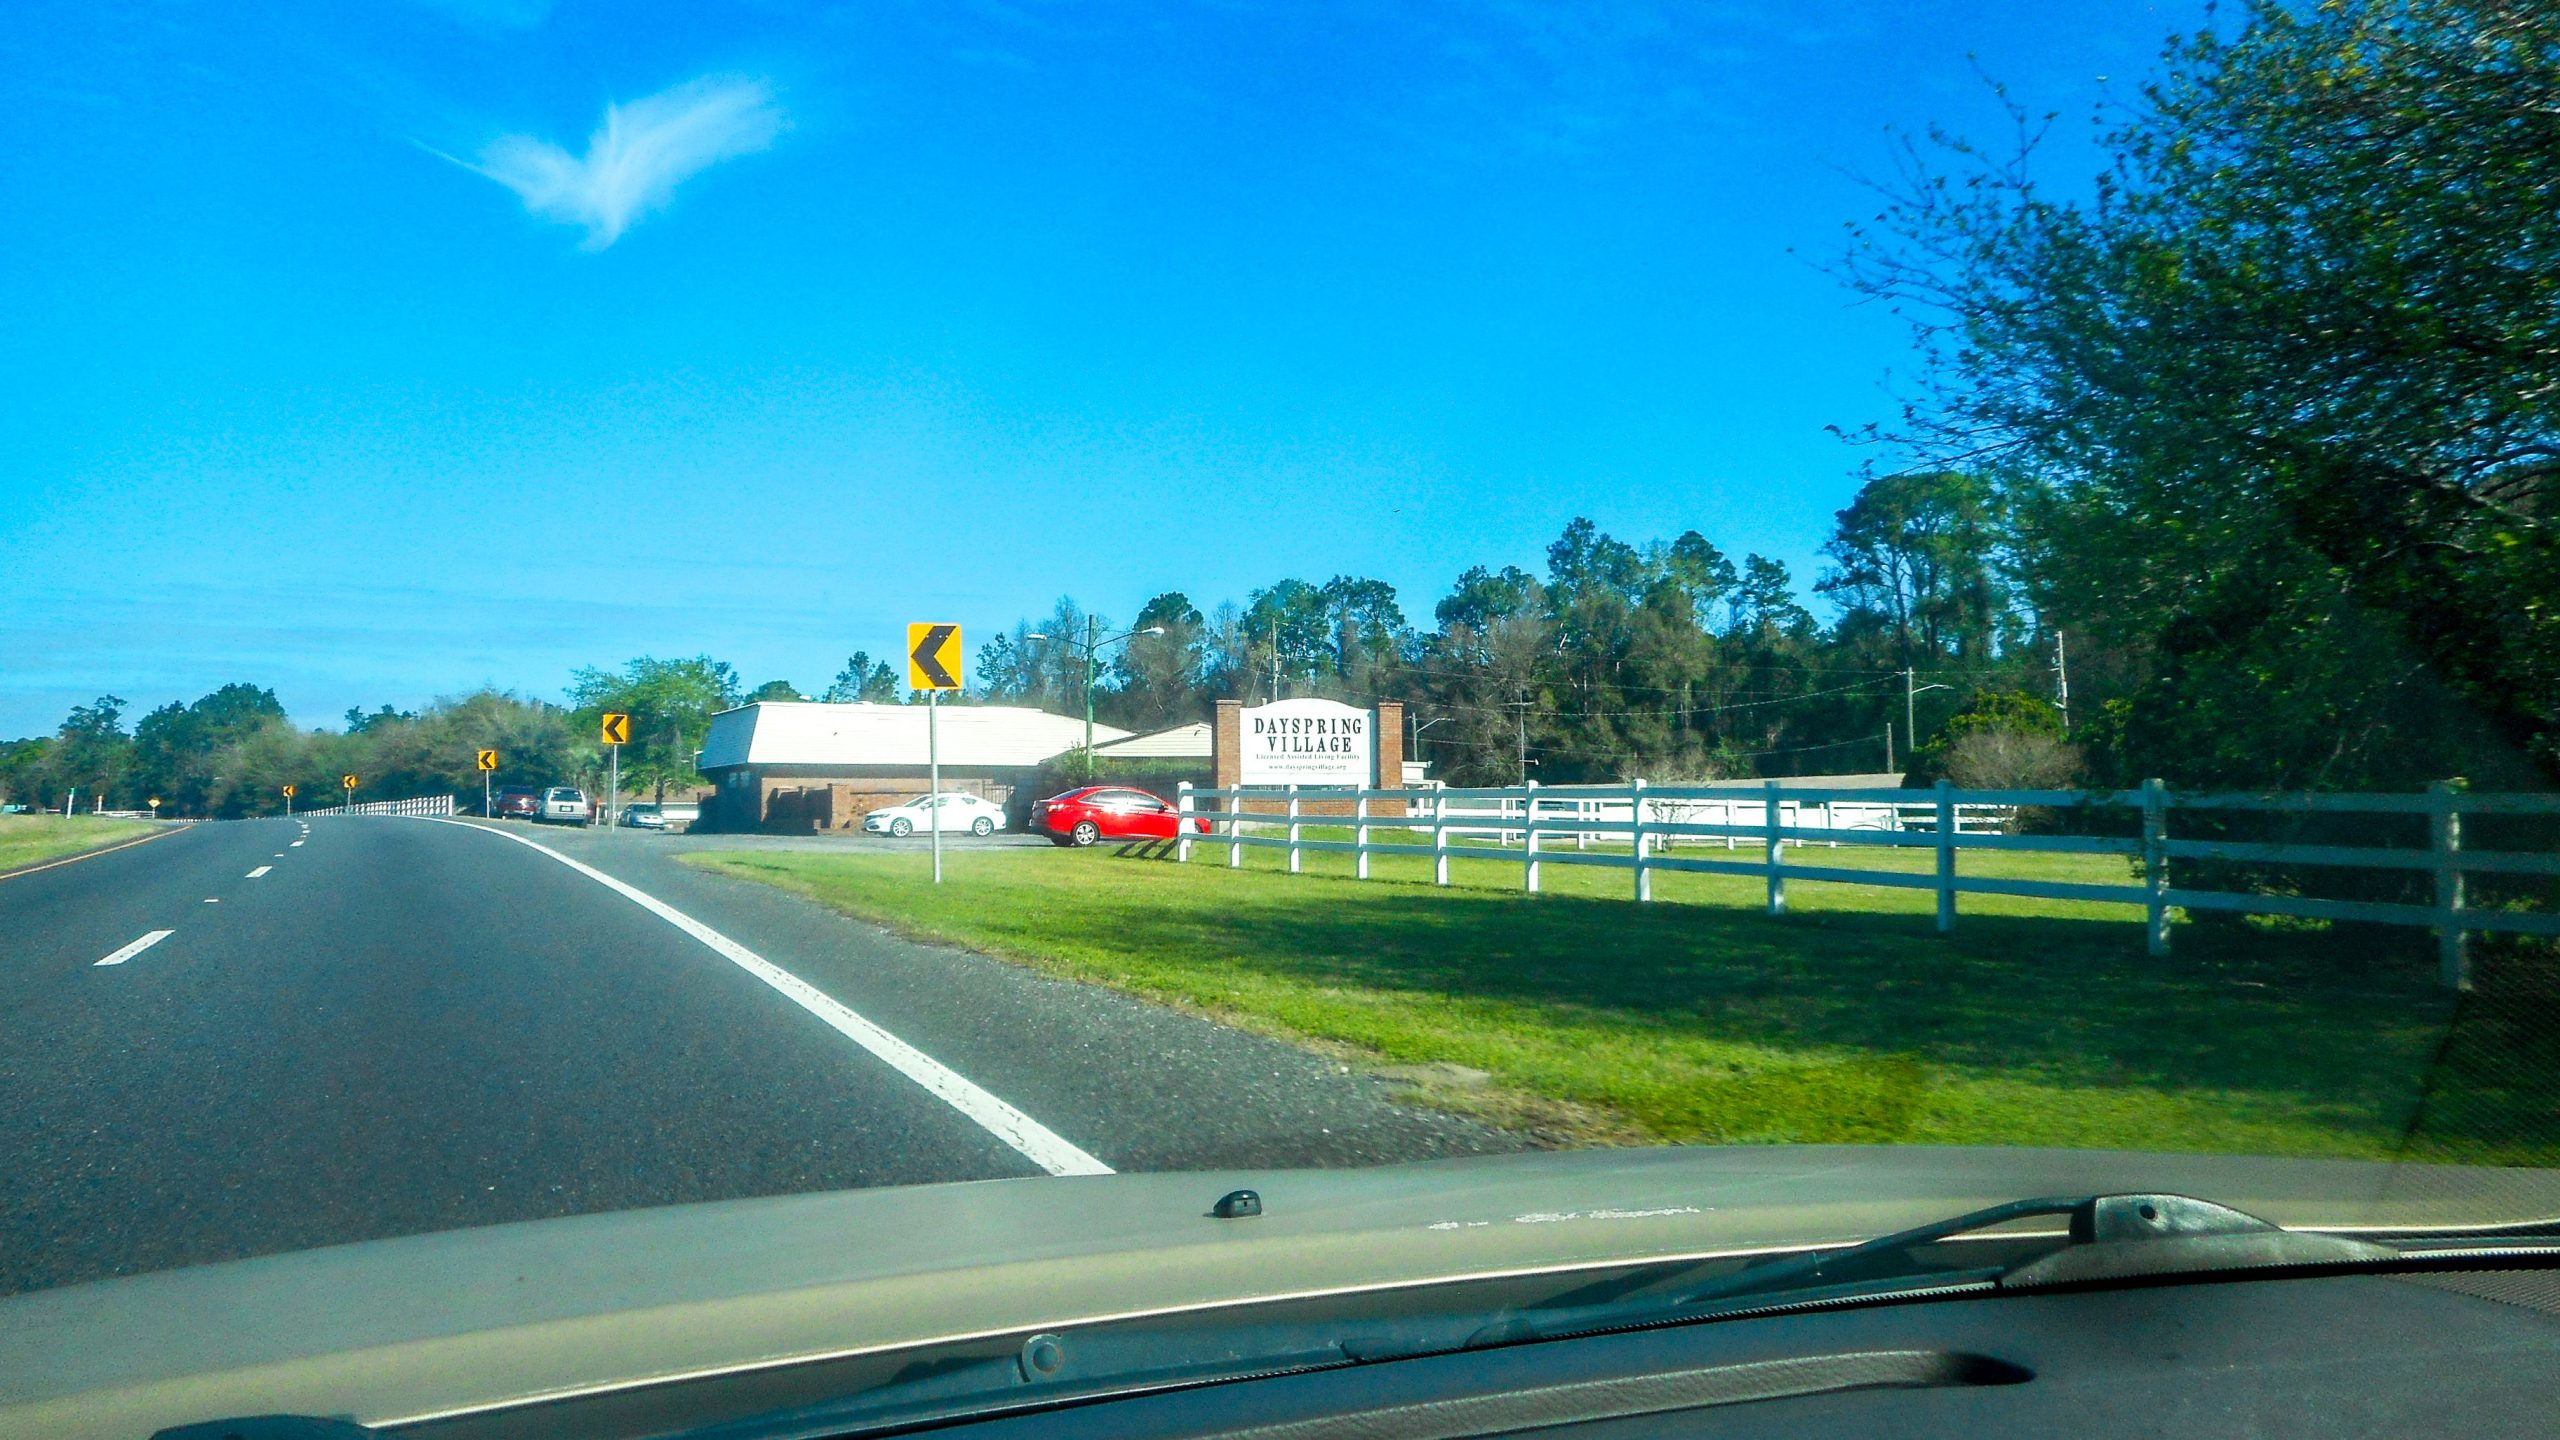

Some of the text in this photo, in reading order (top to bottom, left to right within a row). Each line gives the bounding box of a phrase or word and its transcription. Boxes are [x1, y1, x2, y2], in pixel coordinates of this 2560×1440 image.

[1254, 717, 1362, 734] DAYSPRING
[1267, 736, 1352, 753] VILLAGE
[1314, 753, 1335, 761] Living
[1337, 753, 1360, 761] Facility
